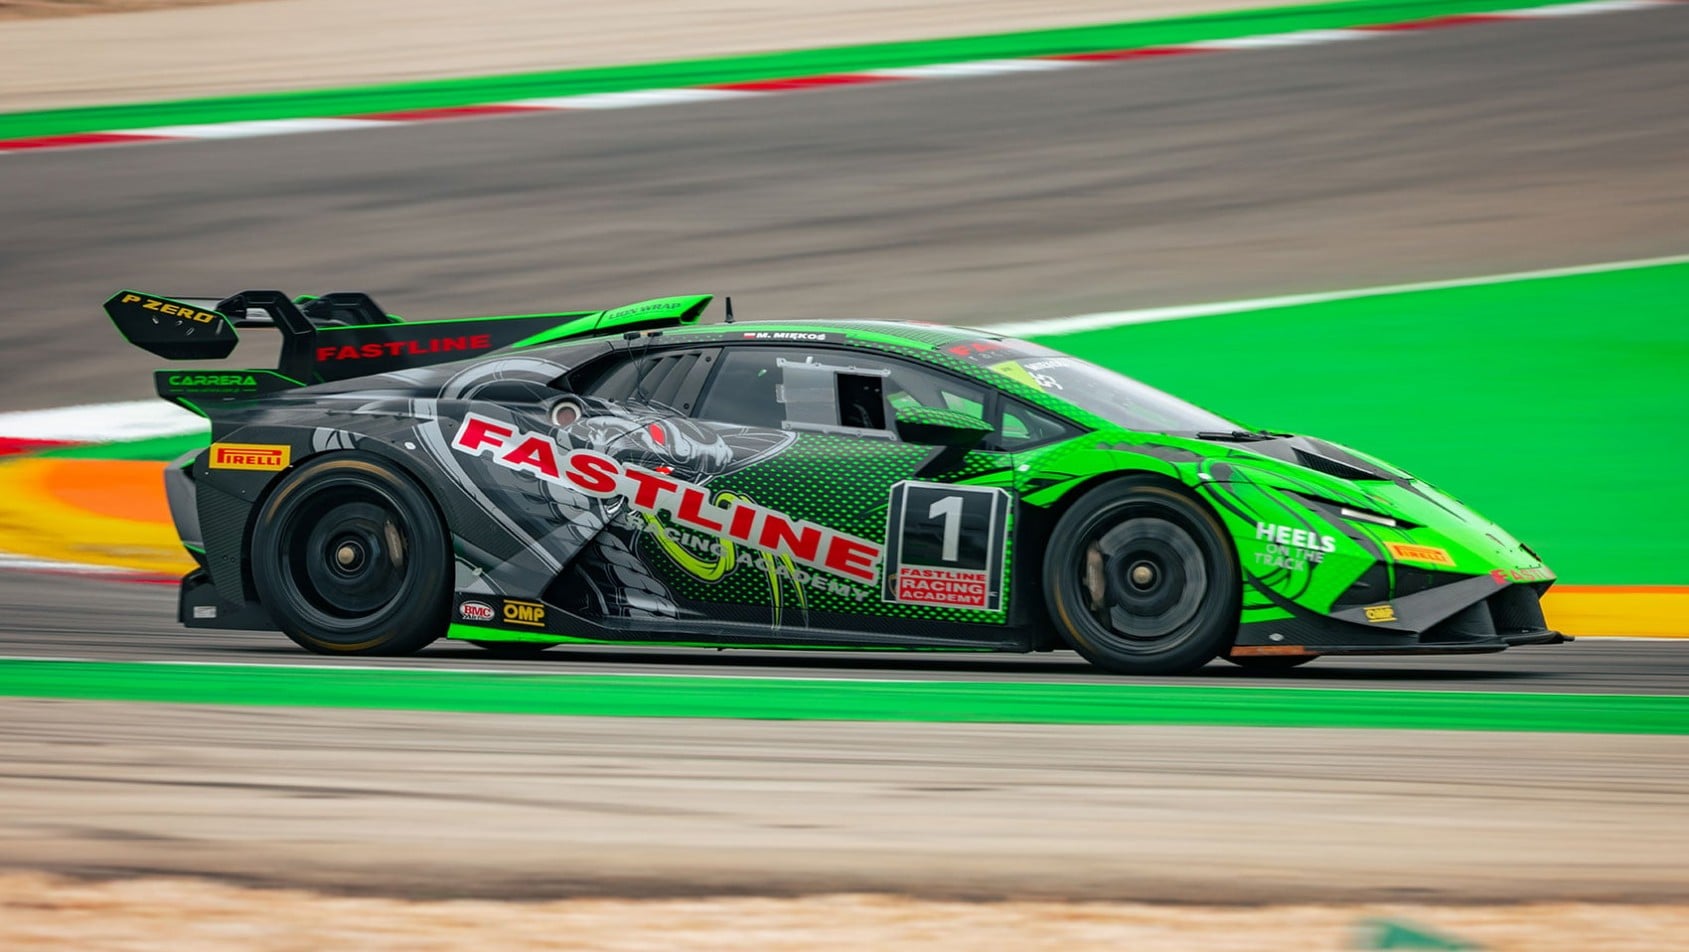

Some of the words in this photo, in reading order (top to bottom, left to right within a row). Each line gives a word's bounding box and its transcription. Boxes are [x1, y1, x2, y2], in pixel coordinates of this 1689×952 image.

[121, 294, 141, 303] P
[142, 299, 215, 324] ZERO
[640, 302, 681, 312] WRAP
[316, 334, 492, 361] FASTLINE
[168, 375, 257, 386] CARRERA
[217, 448, 282, 465] PIRELLI
[456, 416, 881, 583] FASTLINE
[929, 496, 963, 562] 1
[1256, 521, 1336, 552] HEELS
[627, 513, 730, 558] RACING
[735, 552, 869, 602] ACADEMY
[1254, 552, 1304, 571] TRACK
[1266, 543, 1289, 556] ON
[1296, 548, 1324, 564] THE
[1393, 545, 1447, 562] PIRELLI
[901, 568, 987, 581] FASTLINE
[902, 579, 984, 595] RACING
[901, 590, 983, 604] ACADEMY
[464, 605, 491, 617] BMC
[503, 603, 545, 622] OMP
